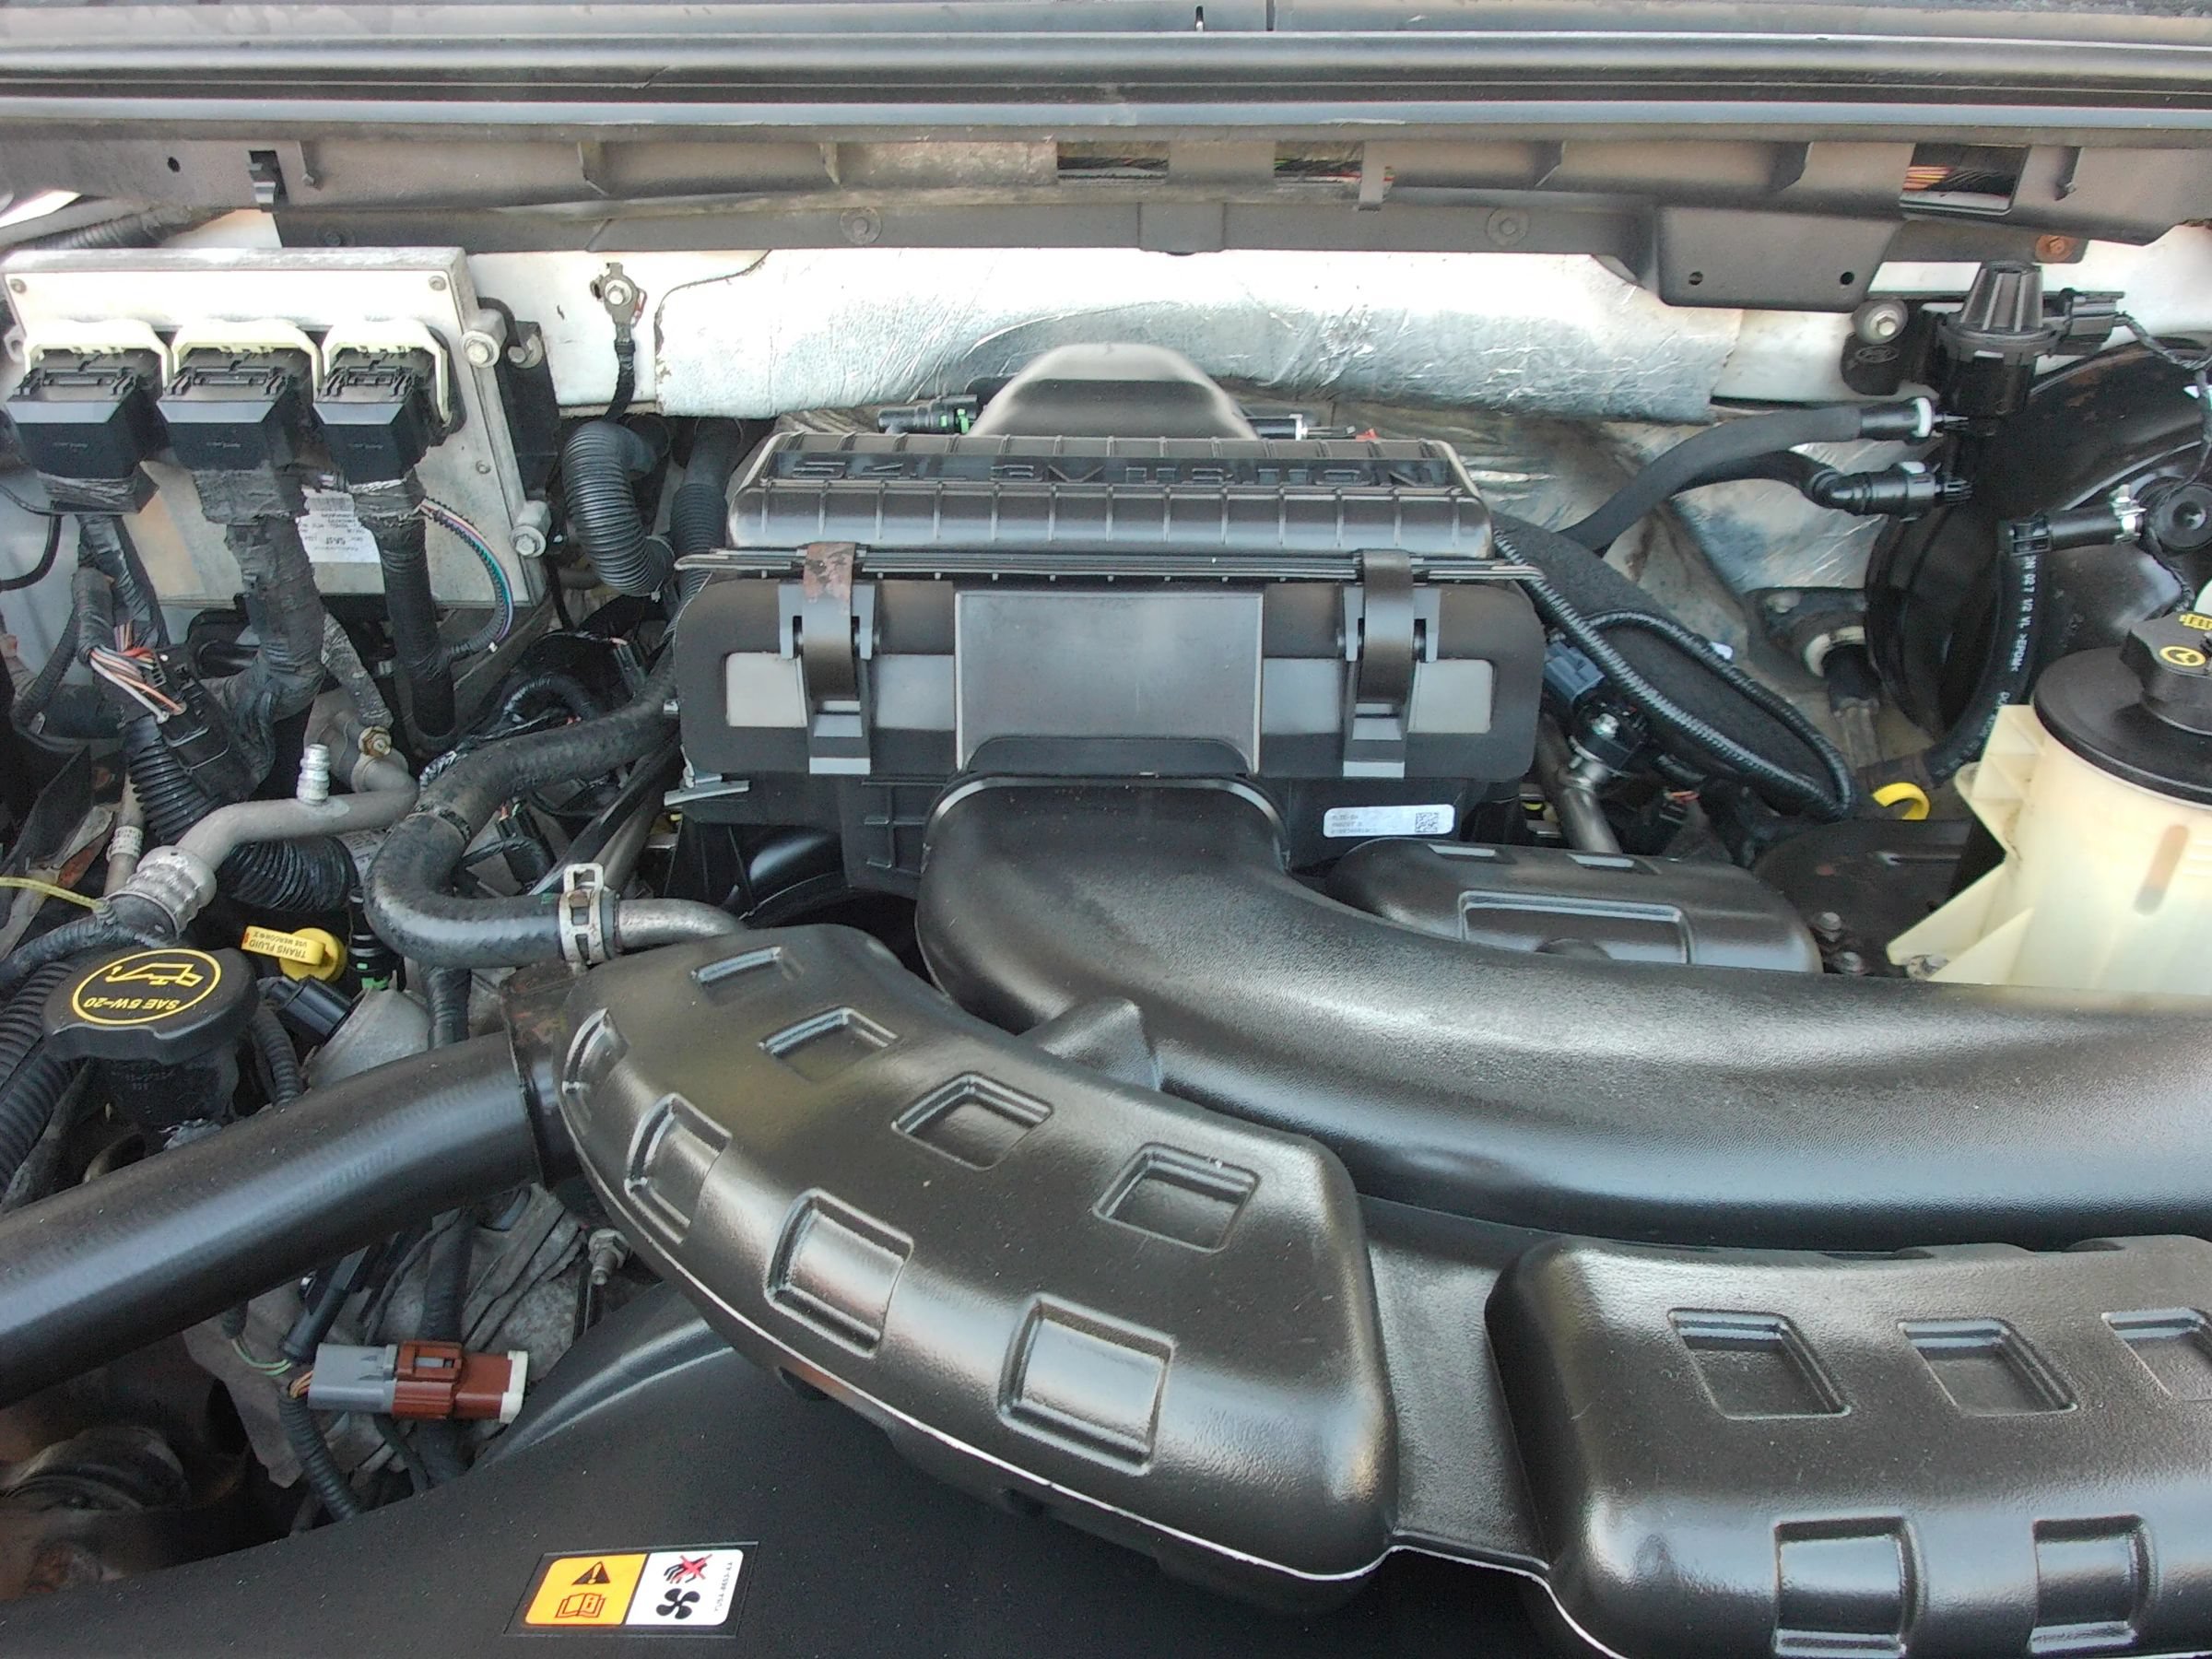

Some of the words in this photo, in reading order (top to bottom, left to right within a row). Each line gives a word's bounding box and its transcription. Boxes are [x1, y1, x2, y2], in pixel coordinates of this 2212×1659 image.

[248, 939, 276, 952] FLUID
[276, 943, 307, 959] TRANS
[84, 997, 142, 1010] 5W-20
[142, 998, 181, 1010] SAE
